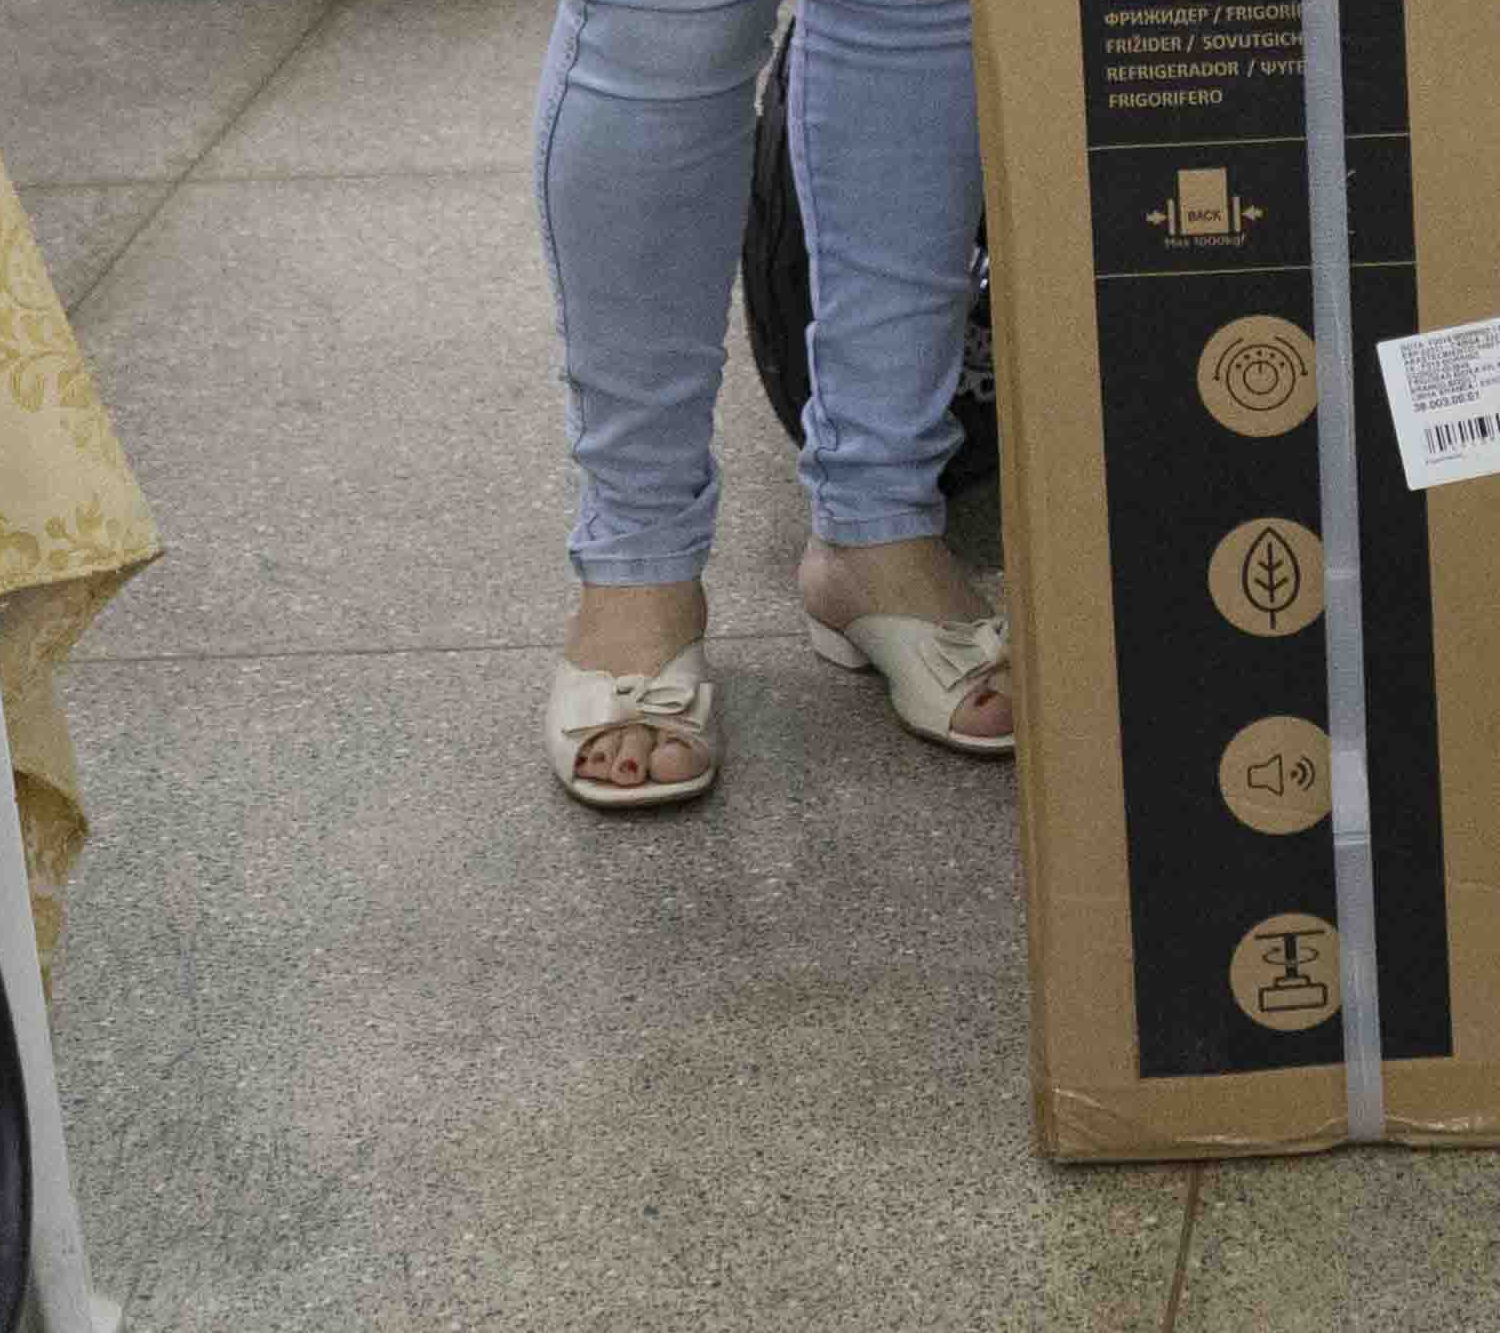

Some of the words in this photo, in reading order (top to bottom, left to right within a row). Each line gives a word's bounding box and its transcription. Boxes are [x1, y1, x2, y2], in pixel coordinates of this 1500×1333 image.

[1105, 34, 1182, 53] FRIŽIDER
[1107, 61, 1239, 82] REFRIGERADOR
[1108, 90, 1223, 109] FRIGORIFERO
[1187, 211, 1223, 223] BACK
